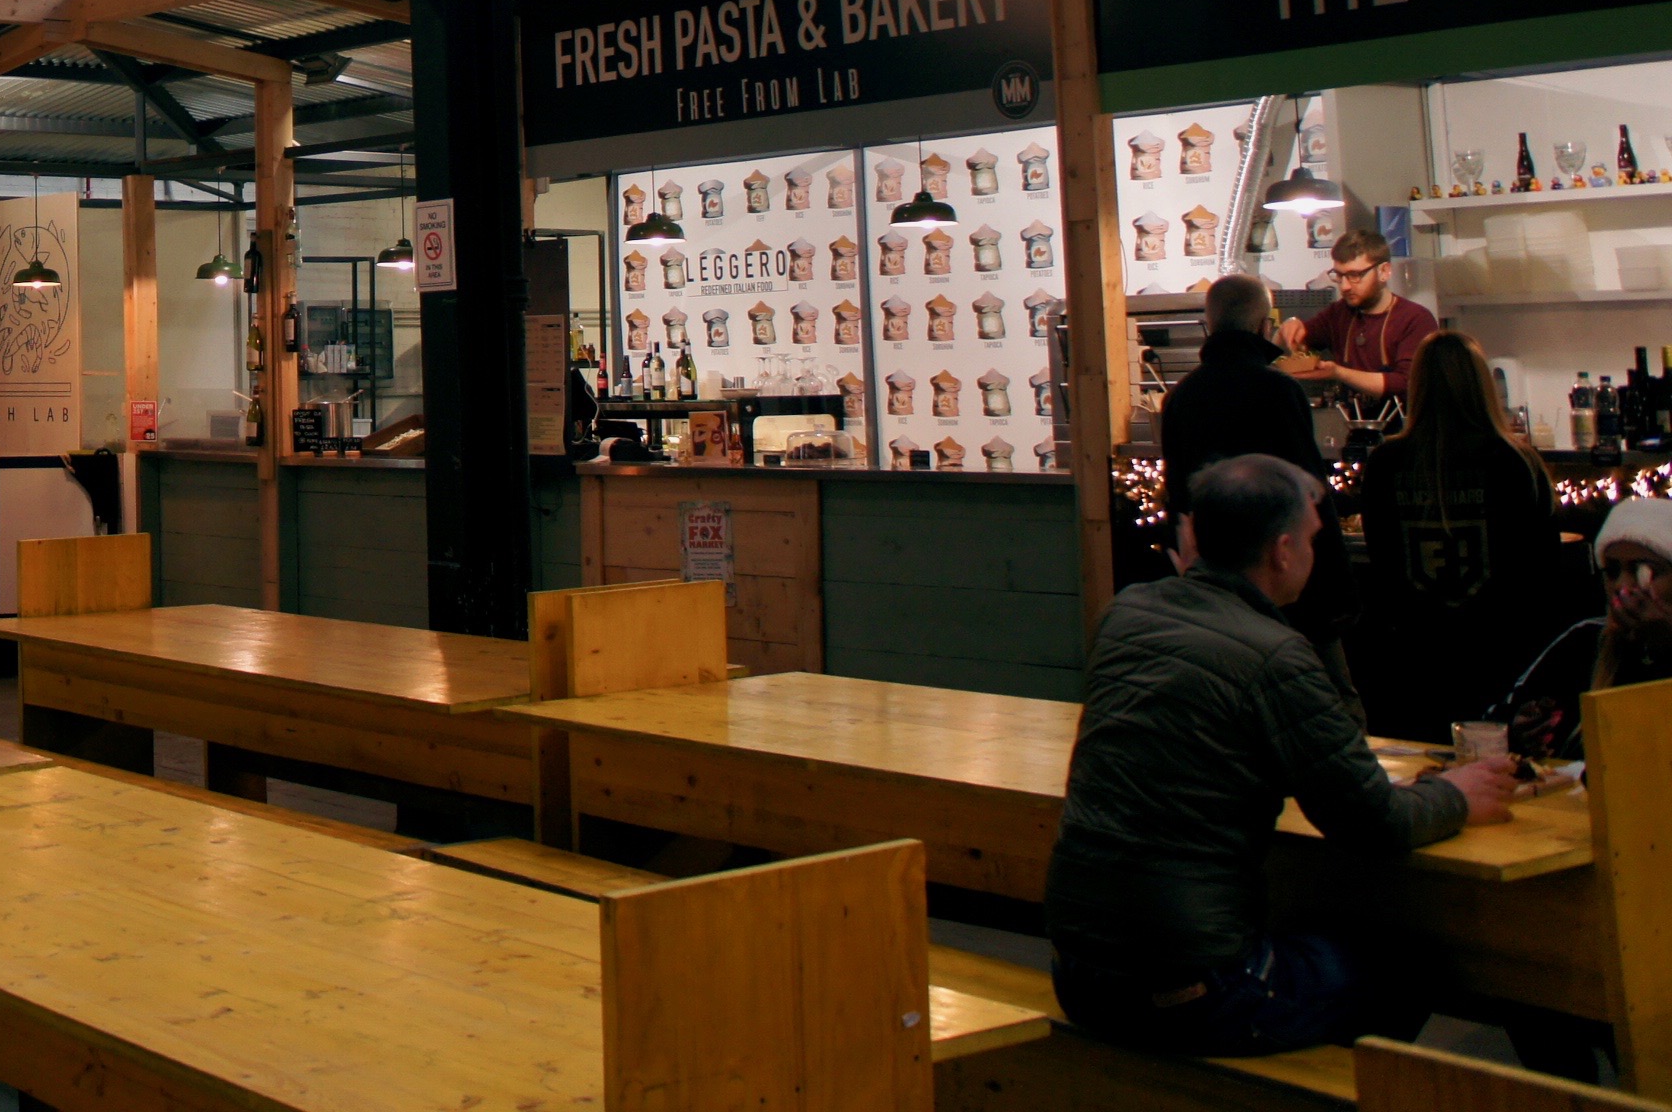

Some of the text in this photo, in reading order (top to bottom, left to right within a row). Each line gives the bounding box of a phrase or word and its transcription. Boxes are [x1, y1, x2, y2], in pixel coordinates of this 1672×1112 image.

[555, 14, 664, 89] FRESH
[428, 212, 437, 220] NO
[419, 221, 446, 230] SMOKING
[685, 249, 787, 282] LEGGERO
[701, 281, 773, 296] REDEFINED ITALIAN FOOD
[33, 407, 69, 422] LAB
[688, 513, 722, 524] Crafty
[688, 526, 723, 540] FOX
[688, 540, 724, 549] MARKET
